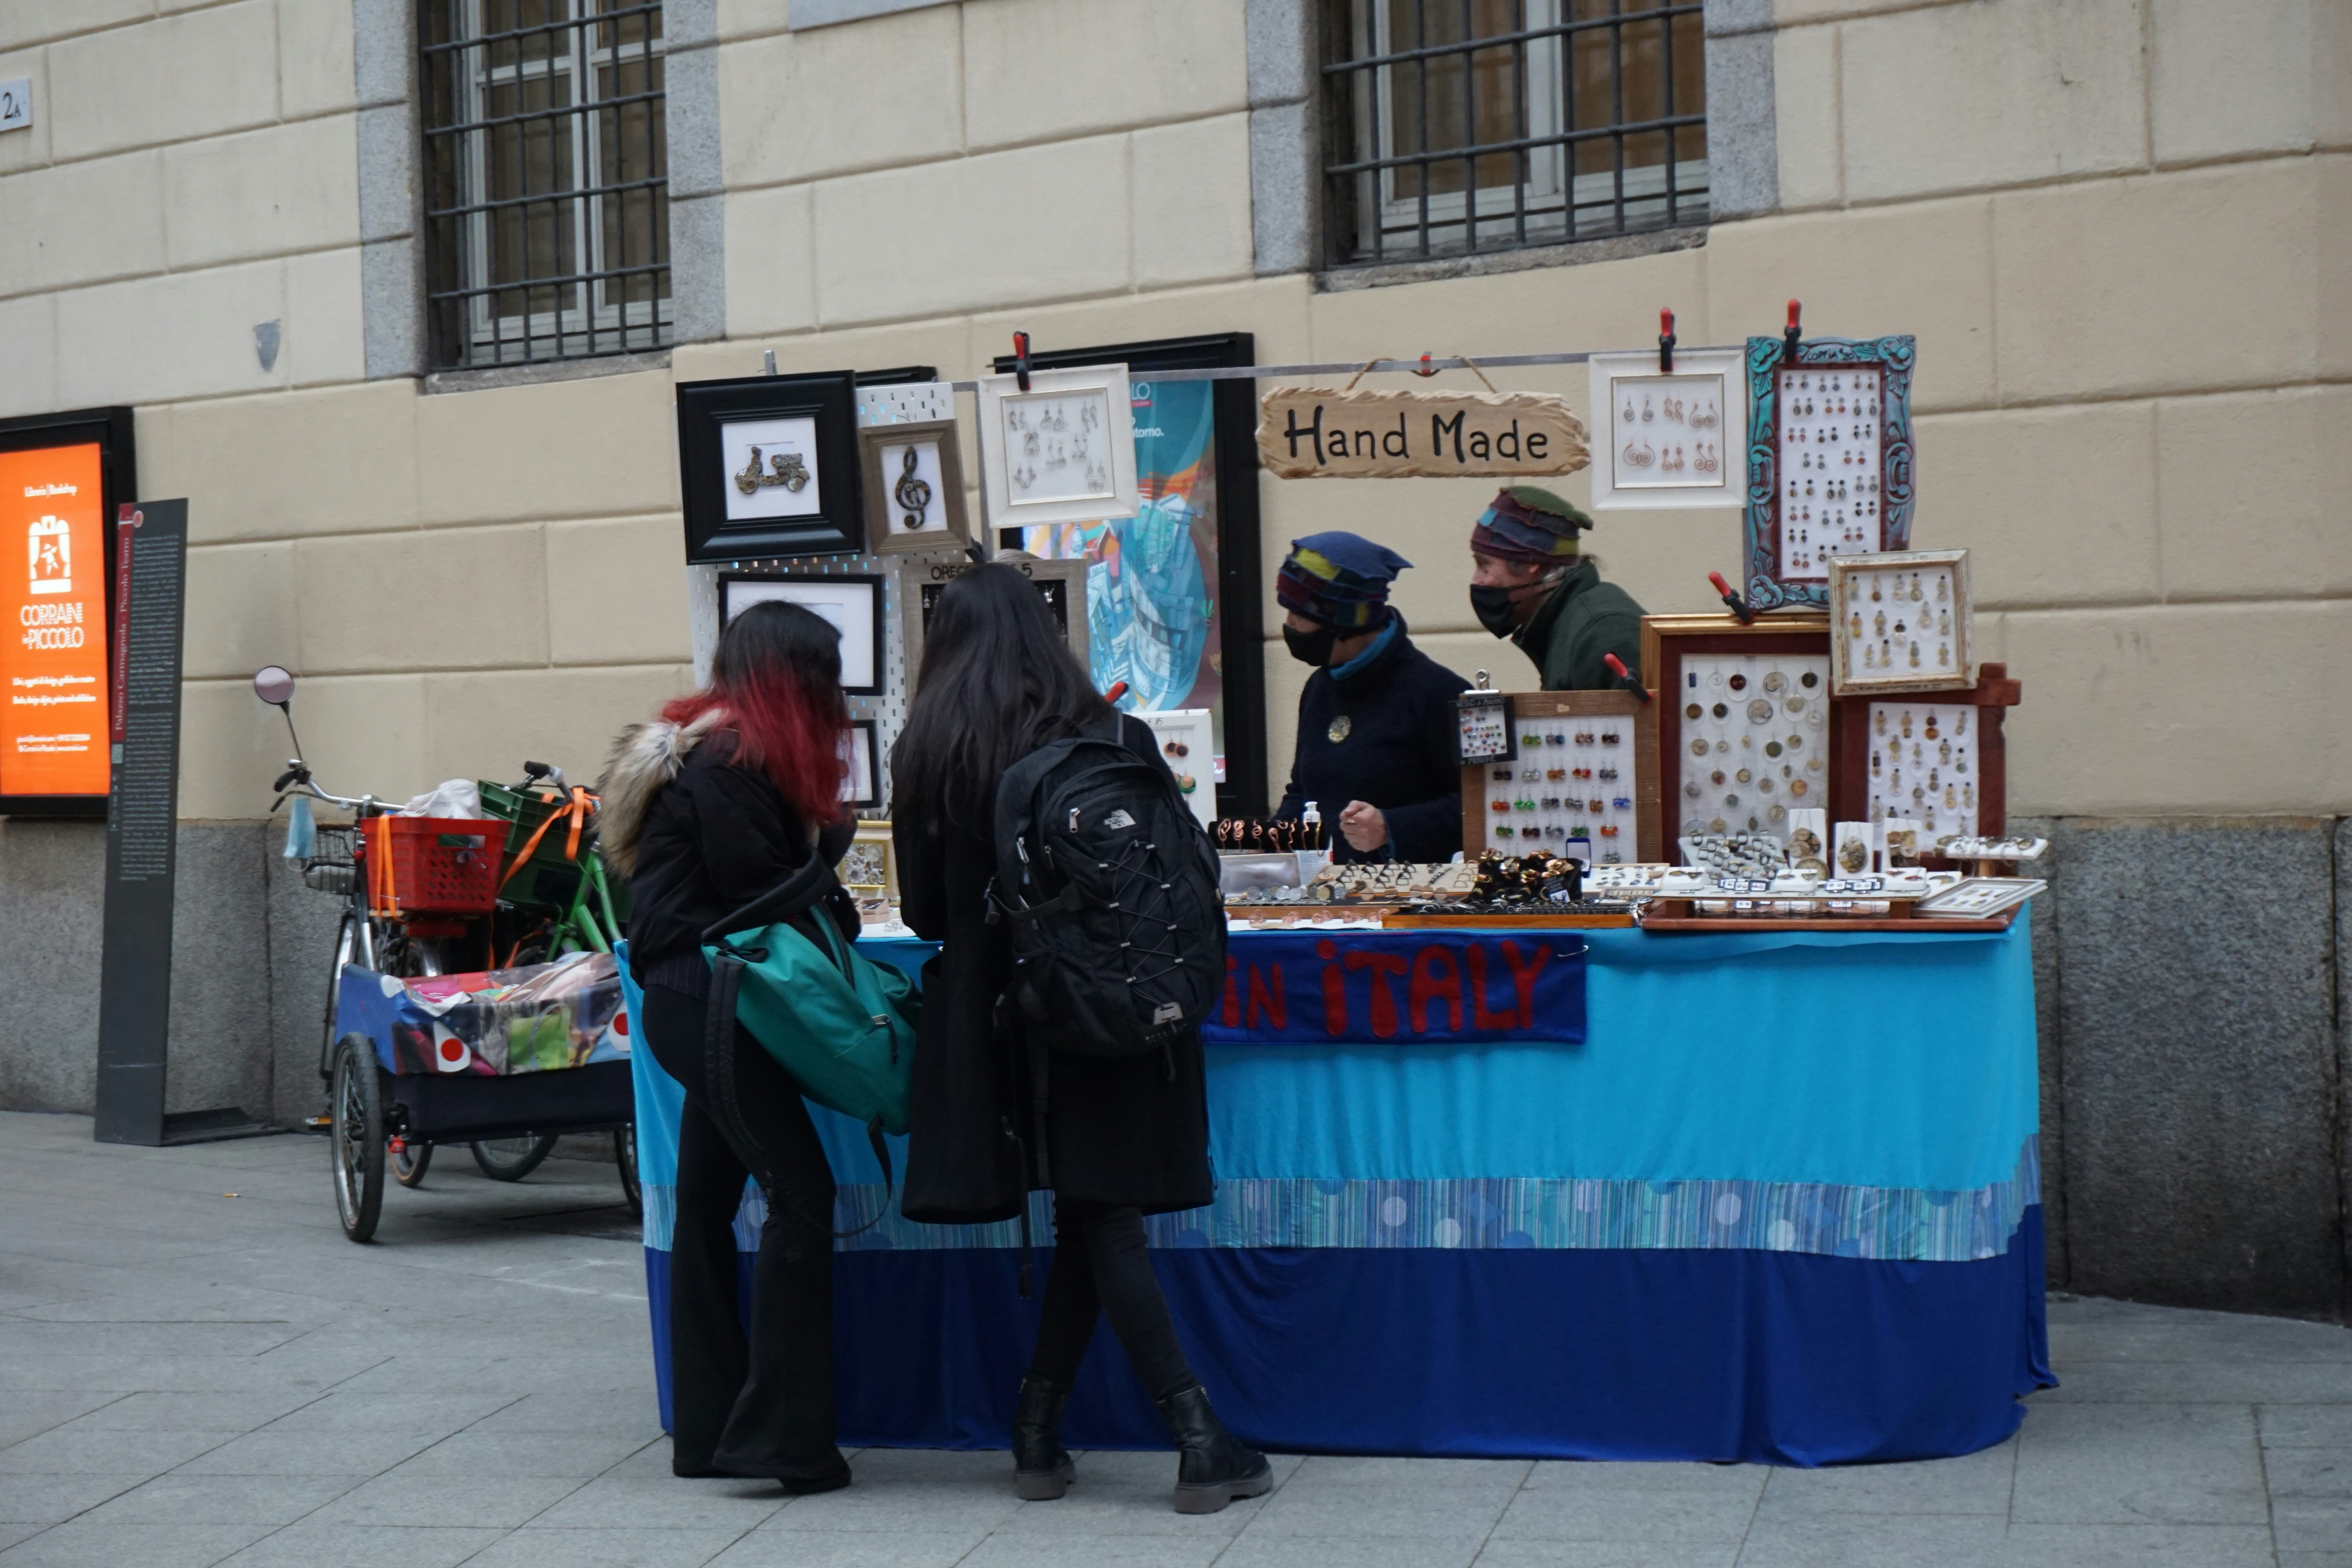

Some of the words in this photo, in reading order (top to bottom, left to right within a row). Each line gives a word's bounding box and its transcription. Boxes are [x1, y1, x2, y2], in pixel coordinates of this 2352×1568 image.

[1284, 405, 1410, 466] Hand
[1432, 410, 1548, 464] Made
[120, 573, 128, 612] Piccolo
[28, 626, 85, 650] PICCOLO
[117, 624, 127, 689] Carmagnola
[114, 692, 124, 731] Palazzo
